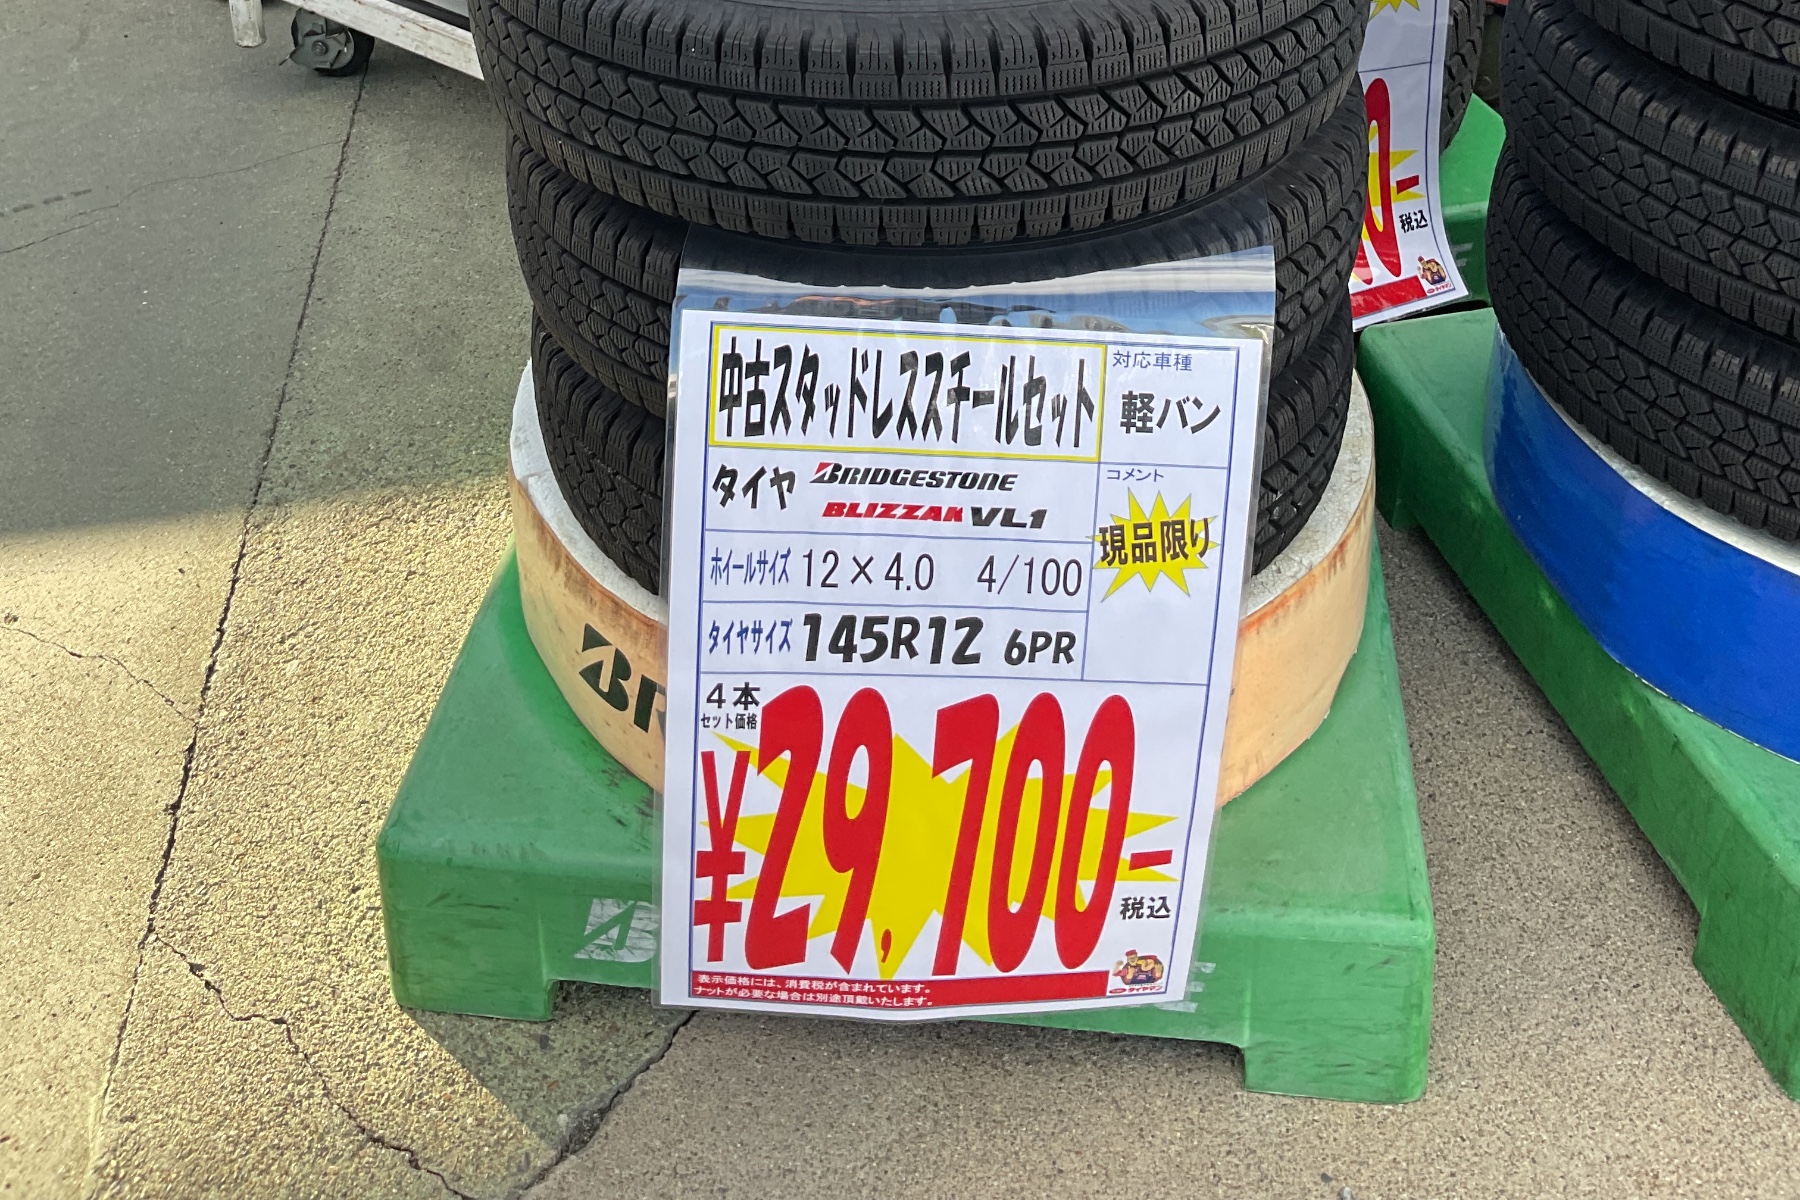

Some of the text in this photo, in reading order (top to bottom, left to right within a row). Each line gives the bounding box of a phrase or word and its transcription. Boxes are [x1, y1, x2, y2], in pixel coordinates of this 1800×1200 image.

[1399, 209, 1429, 234] 税込
[1112, 349, 1193, 373] 対応車種
[719, 335, 1095, 449] 中古スタッドレススチールセット
[1119, 391, 1221, 435] 軽バン
[711, 463, 796, 510] タイヤ
[810, 461, 1018, 492] BRIDGESTONE
[1106, 468, 1164, 482] コメント
[969, 506, 1048, 529] VL1
[1099, 516, 1210, 566] 現品限り
[709, 548, 791, 588] ホイールサイズ
[977, 553, 1083, 597] 4/100
[707, 617, 792, 656] タイヤサイズ
[803, 612, 1077, 667] 145R12 6PR
[699, 712, 758, 731] セット価格
[1119, 895, 1171, 920] 税込
[698, 973, 931, 994] 表示価格には、消費税が含まれています。
